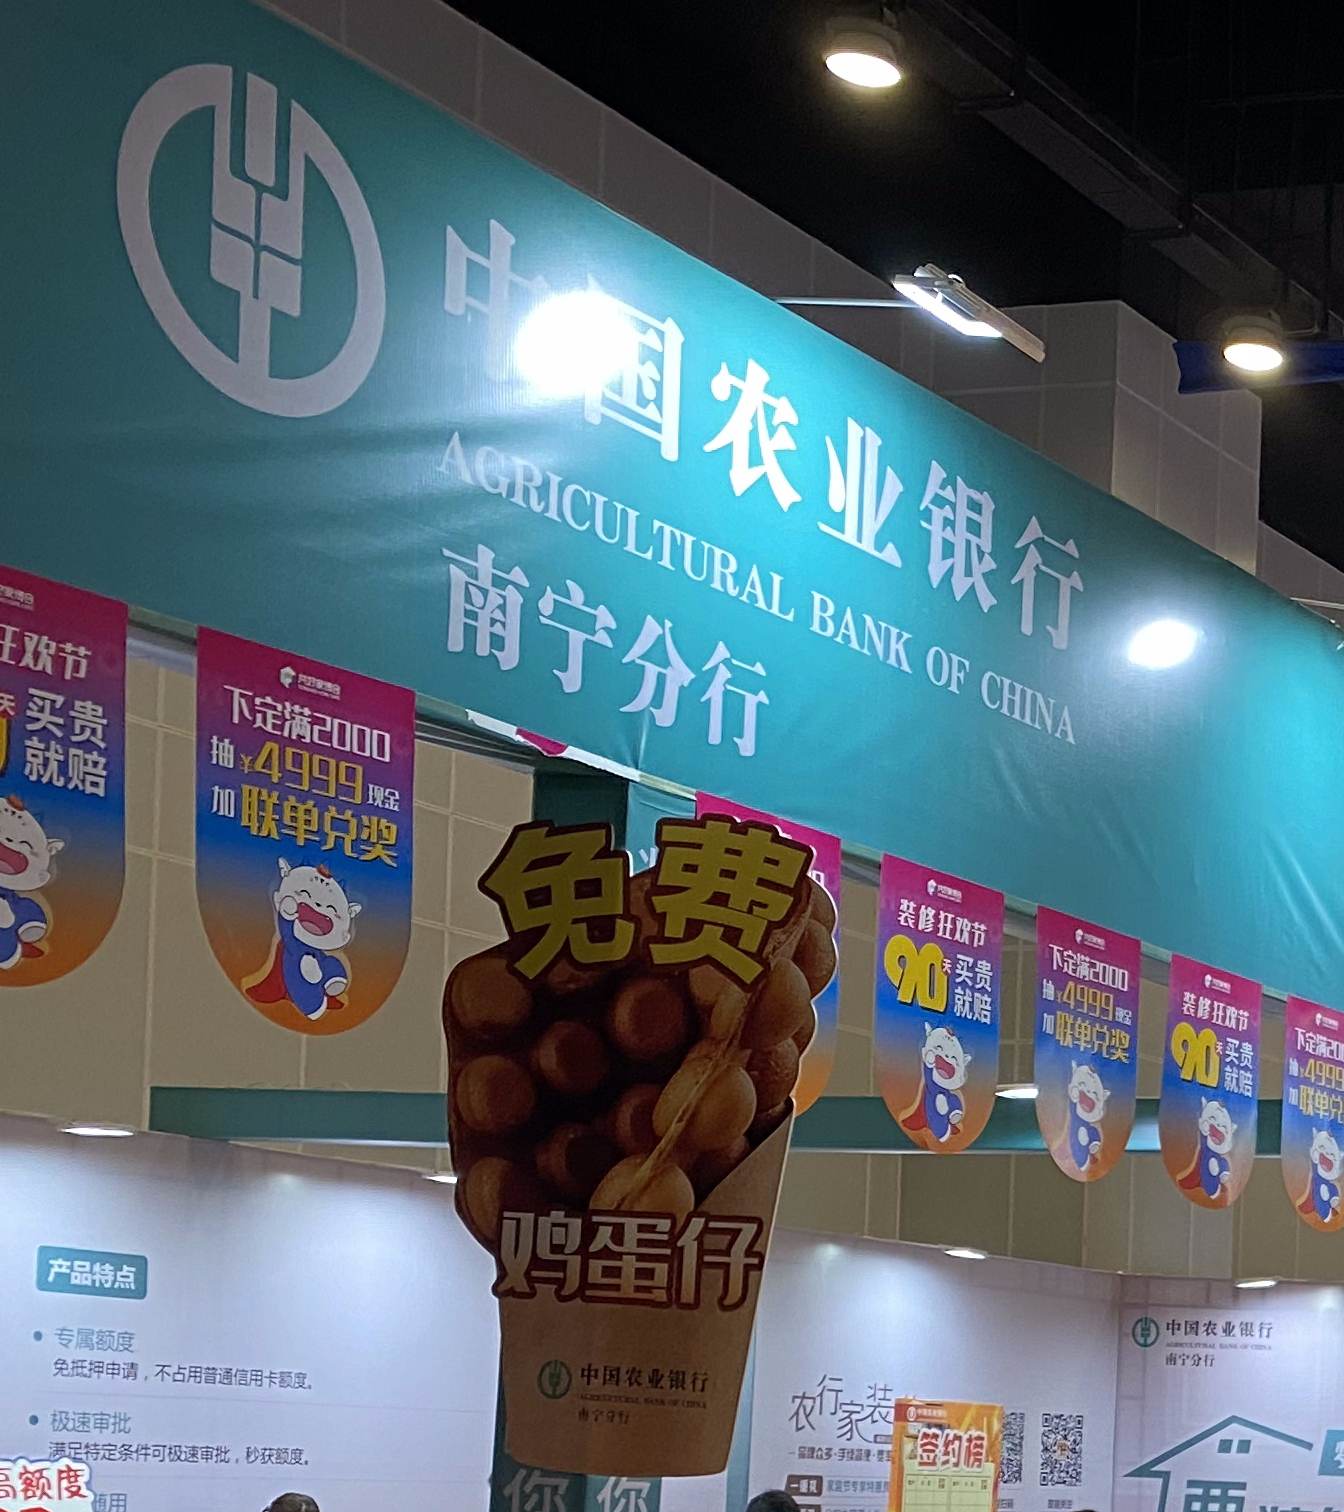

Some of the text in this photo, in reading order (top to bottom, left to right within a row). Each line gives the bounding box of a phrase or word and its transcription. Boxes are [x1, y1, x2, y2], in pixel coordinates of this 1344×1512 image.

[438, 431, 1077, 746] AGRICULTURAL BANK OF CHINA
[441, 542, 770, 757] 南宁分行
[25, 687, 109, 751] 买贵
[223, 684, 392, 764] 下定满2000
[24, 736, 108, 798] 就赔
[210, 783, 398, 868] 加联单兑奖
[488, 818, 808, 982] 免费
[897, 898, 988, 948] 装修狂欢节
[954, 953, 994, 993] 买贵
[1048, 943, 1129, 992] 下定满2000
[953, 987, 993, 1026] 就赔
[1181, 991, 1250, 1032] 装修狂欢节
[1224, 1037, 1254, 1070] 买贵
[48, 1257, 137, 1291] 产品特点
[499, 1209, 764, 1308] 鸡蛋仔
[53, 1327, 136, 1353] 专属额度
[1165, 1319, 1273, 1339] 中国农业银行
[580, 1363, 709, 1393] 中国农业银行
[1165, 1353, 1216, 1368] 南宁分行
[50, 1410, 132, 1434] 极速审批
[917, 1429, 987, 1470] 签约榜
